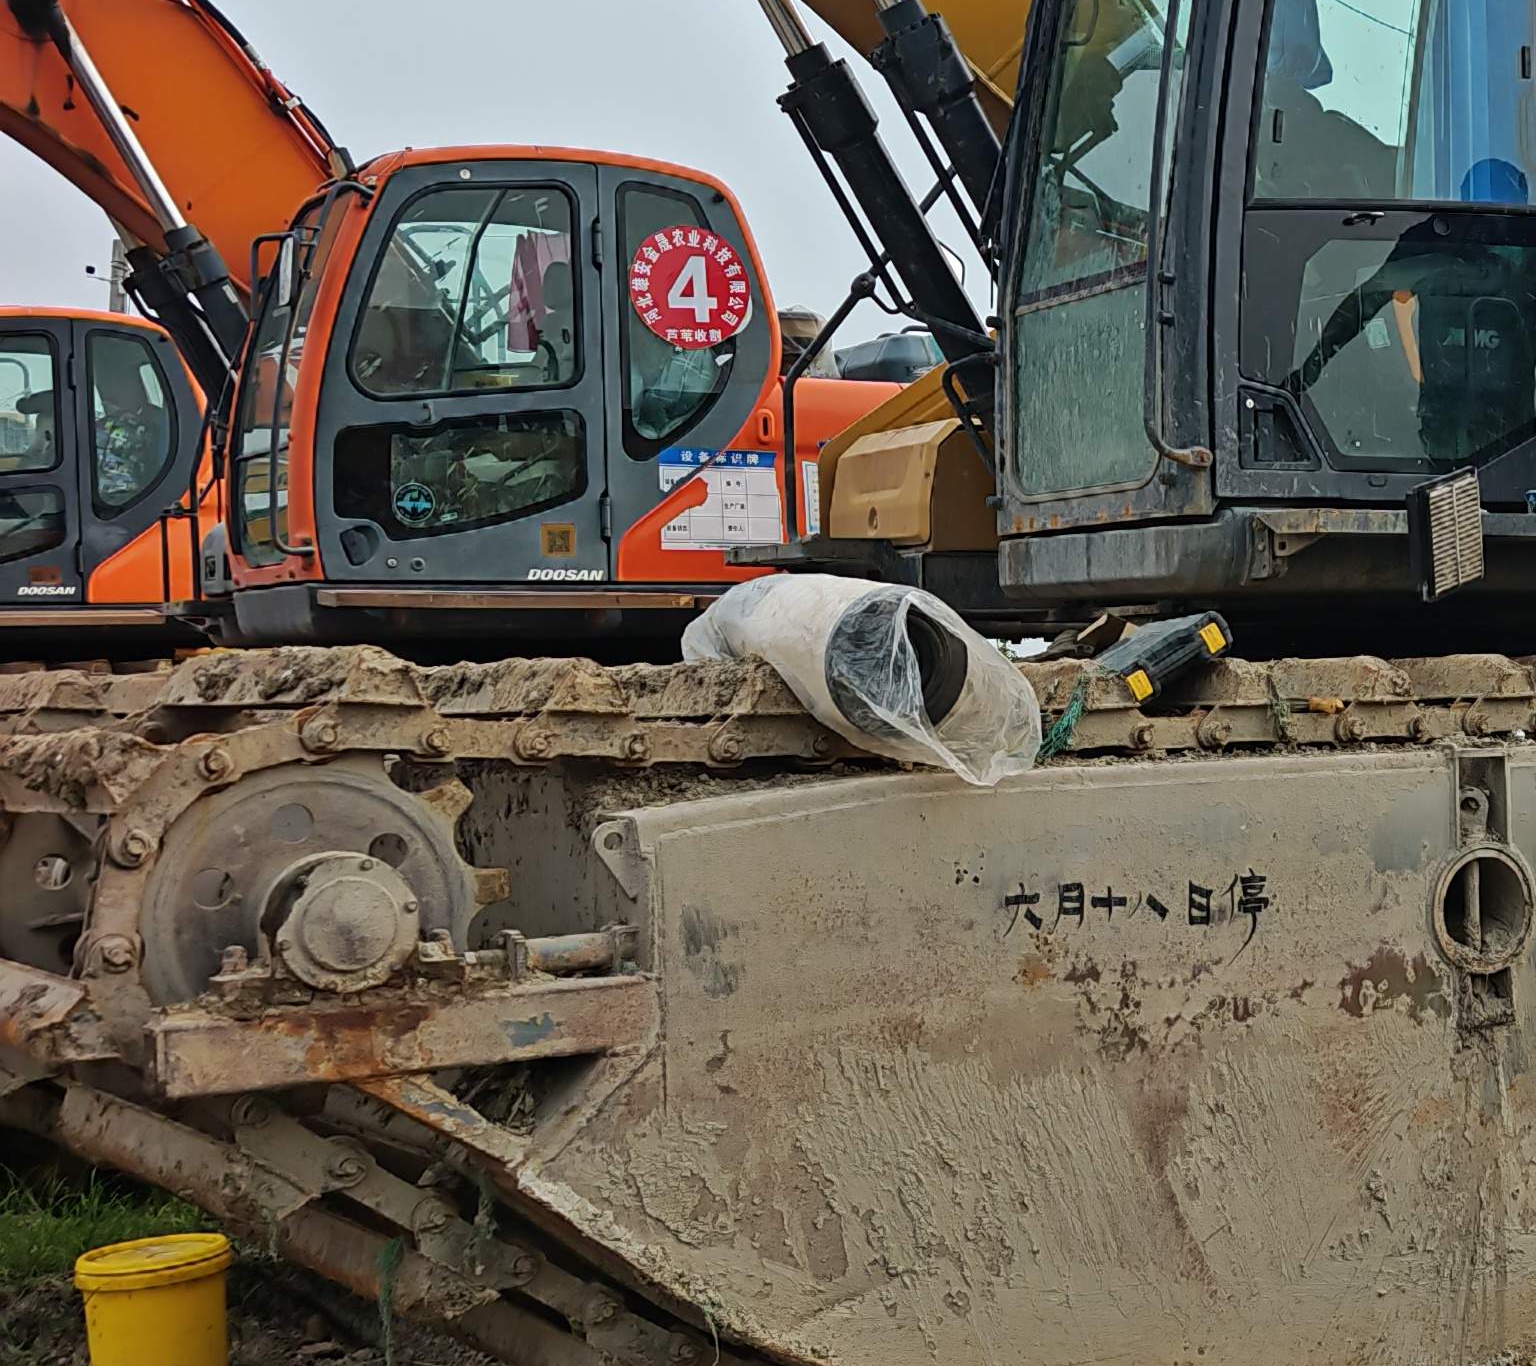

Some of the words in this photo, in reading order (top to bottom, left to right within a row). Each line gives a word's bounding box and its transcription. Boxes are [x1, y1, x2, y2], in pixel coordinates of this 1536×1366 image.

[667, 255, 718, 323] 4
[665, 328, 721, 343] 芦苇收割
[680, 450, 760, 465] 设备标识牌
[527, 568, 604, 581] DOOSAN
[17, 586, 76, 595] DOOSAN
